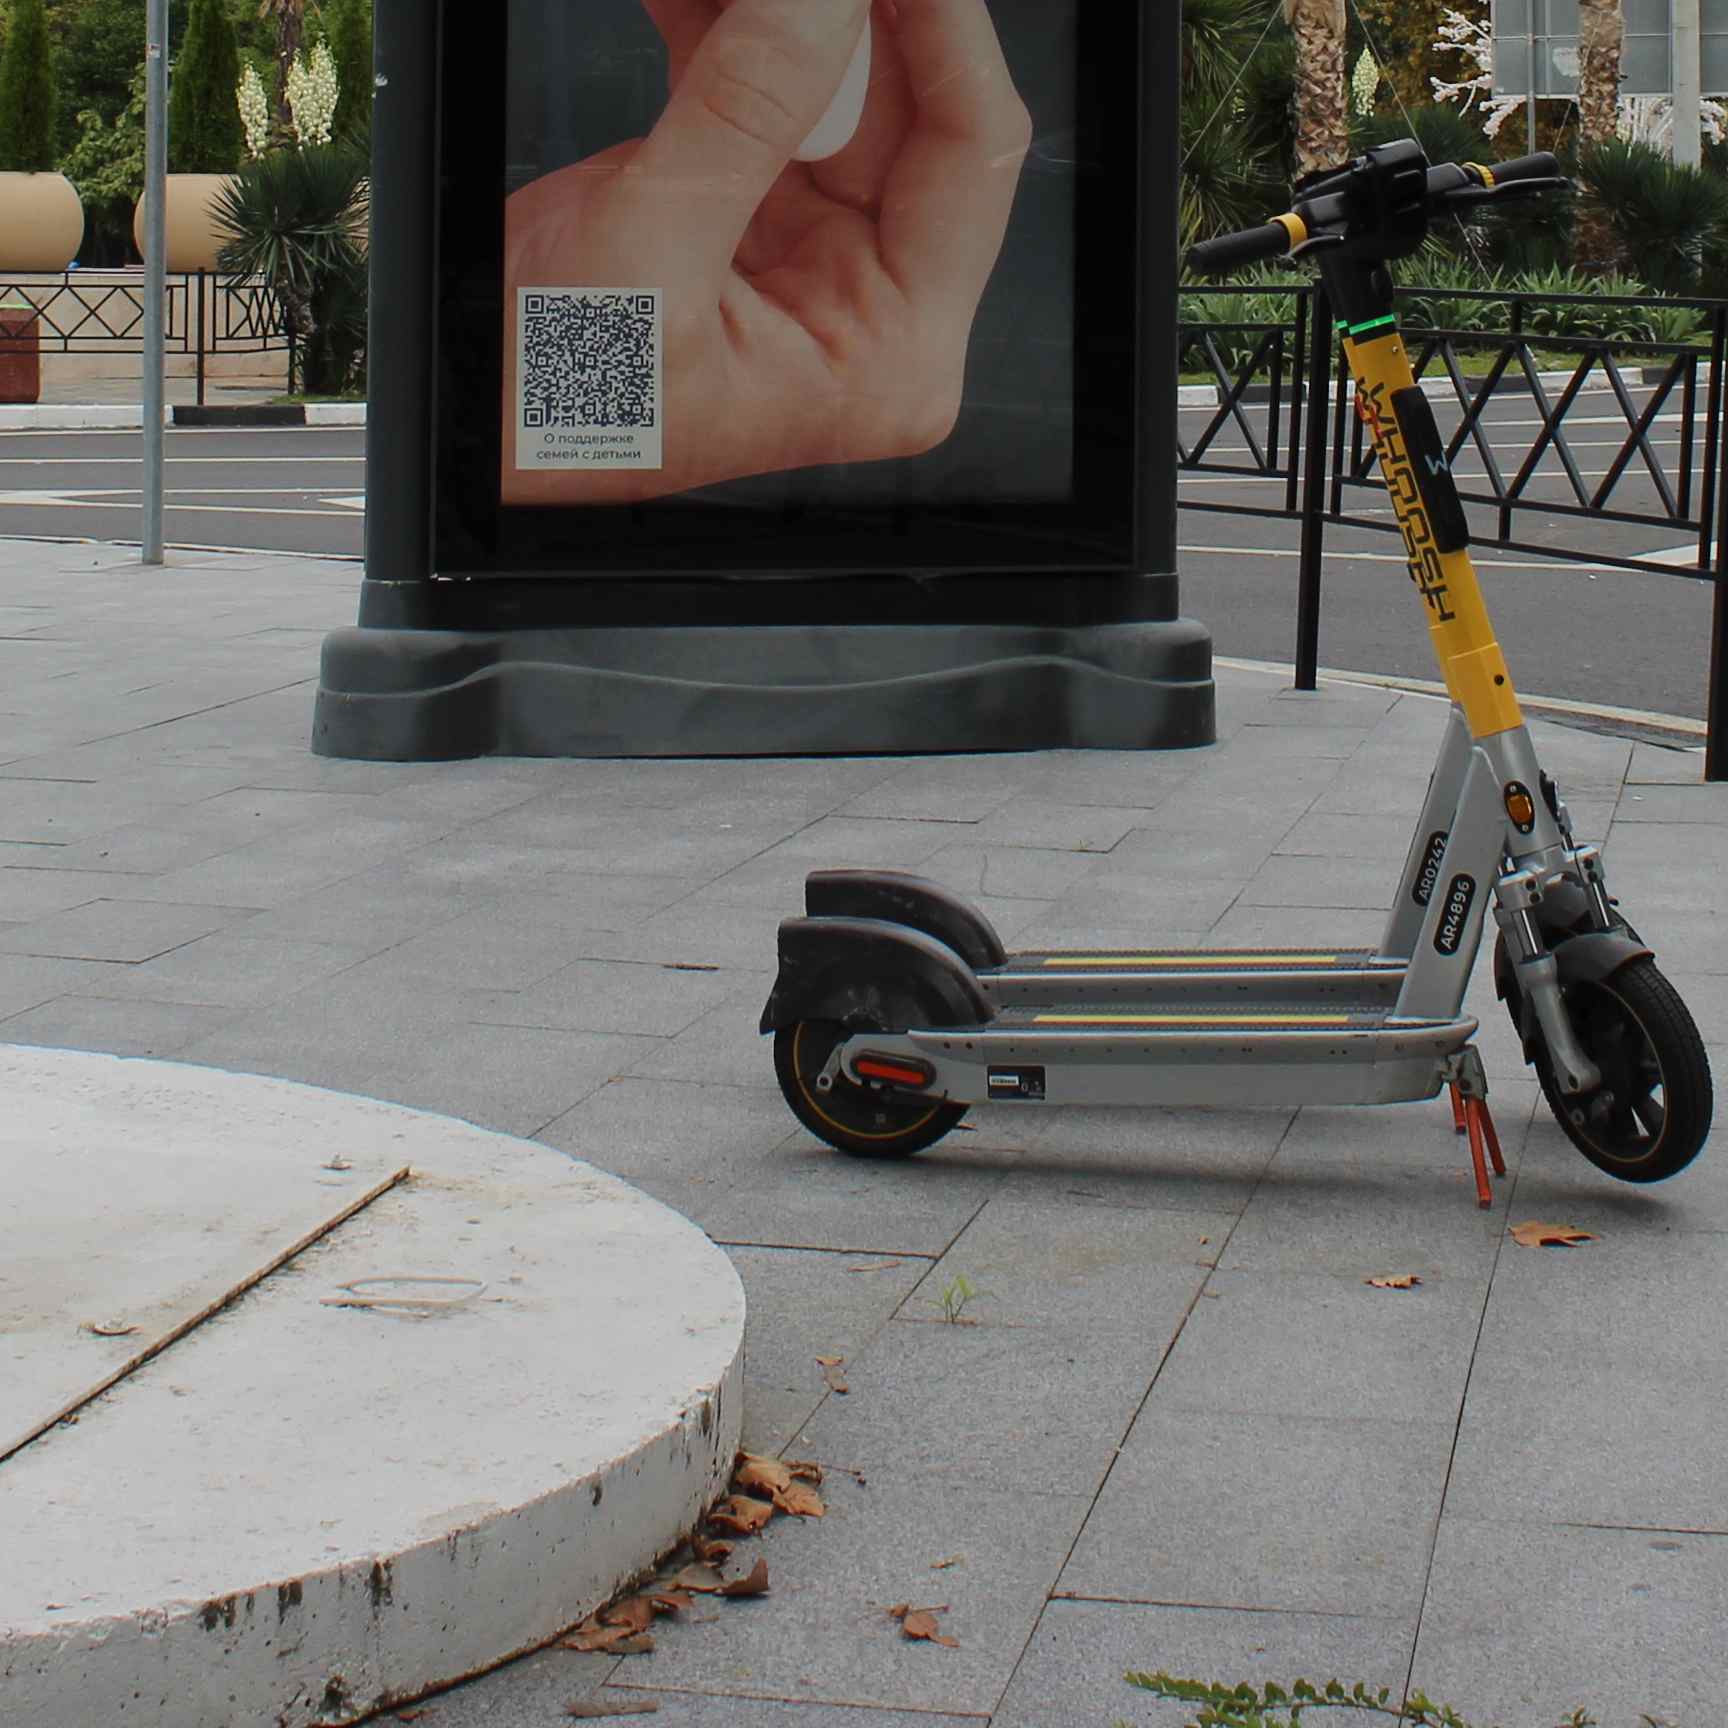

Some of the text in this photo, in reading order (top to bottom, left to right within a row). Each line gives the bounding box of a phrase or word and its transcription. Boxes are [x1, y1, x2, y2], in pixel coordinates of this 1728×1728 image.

[536, 449, 579, 460] семей
[591, 451, 641, 460] детьми
[558, 434, 634, 446] поддержке
[1418, 837, 1448, 902] AR0242
[1440, 880, 1470, 950] AR4896
